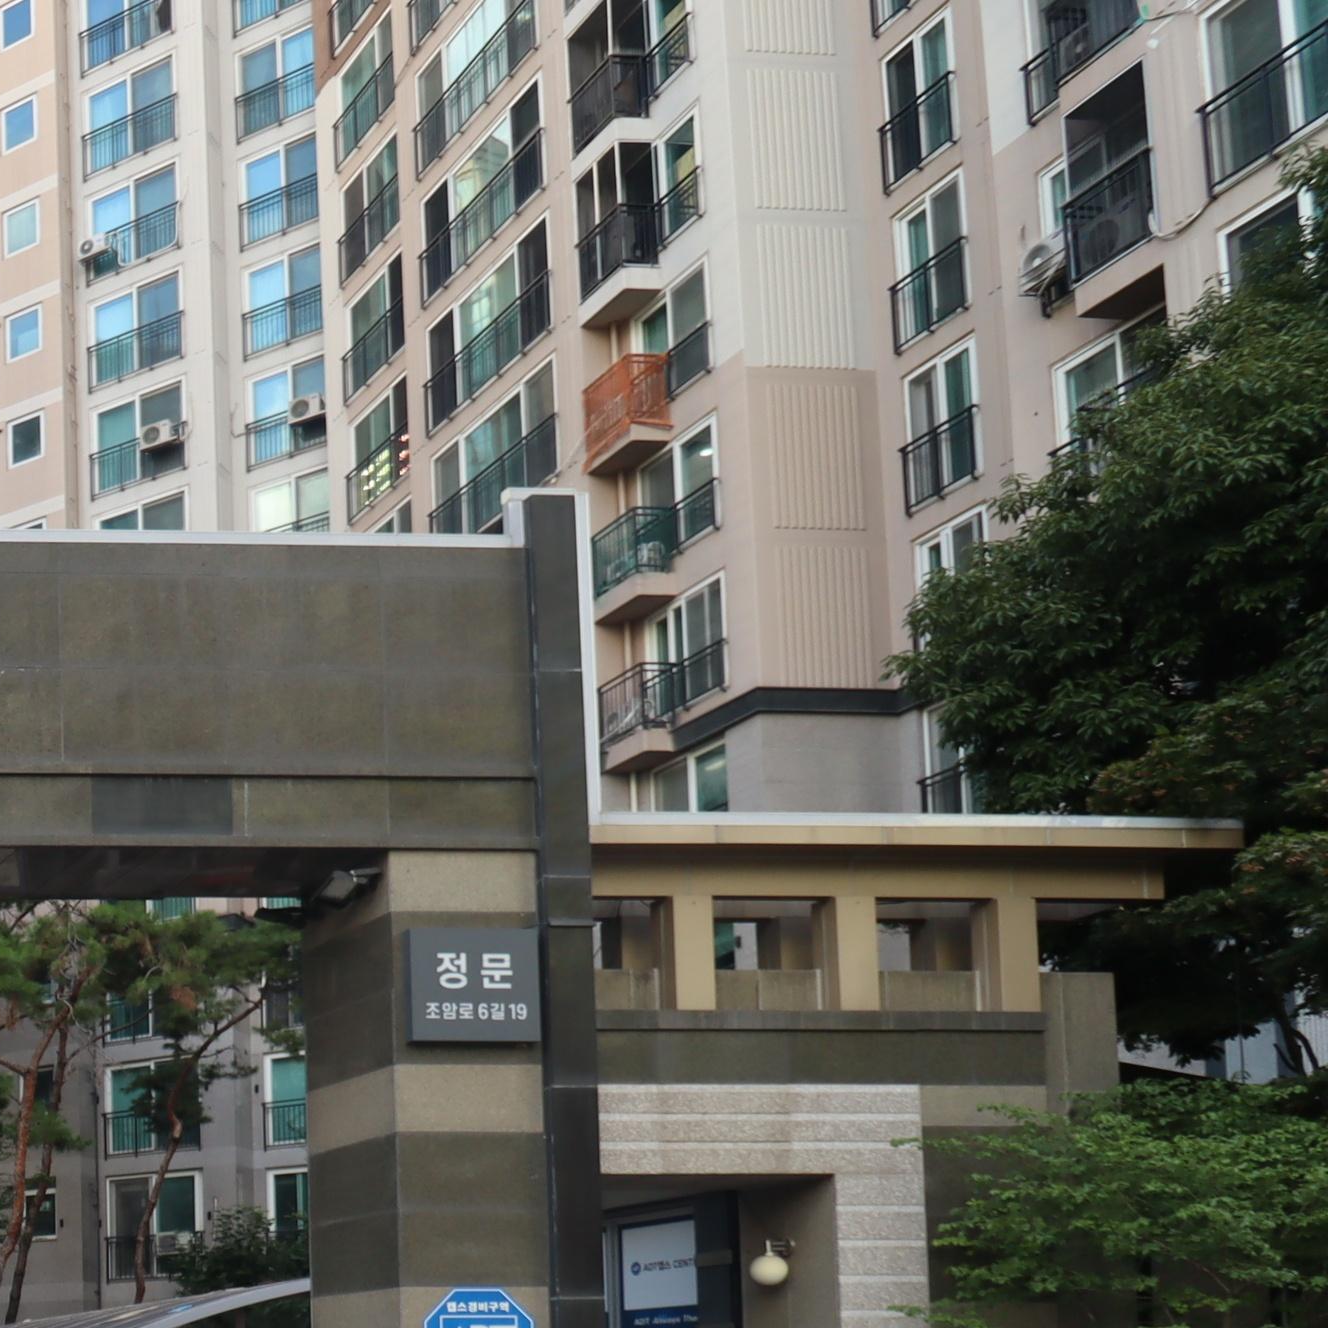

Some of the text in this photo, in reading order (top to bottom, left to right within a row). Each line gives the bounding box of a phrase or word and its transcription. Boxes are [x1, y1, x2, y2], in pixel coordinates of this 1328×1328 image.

[436, 952, 513, 990] 정문
[425, 1002, 528, 1020] 조암로 6길 19
[446, 1301, 510, 1313] 캡스경비구역
